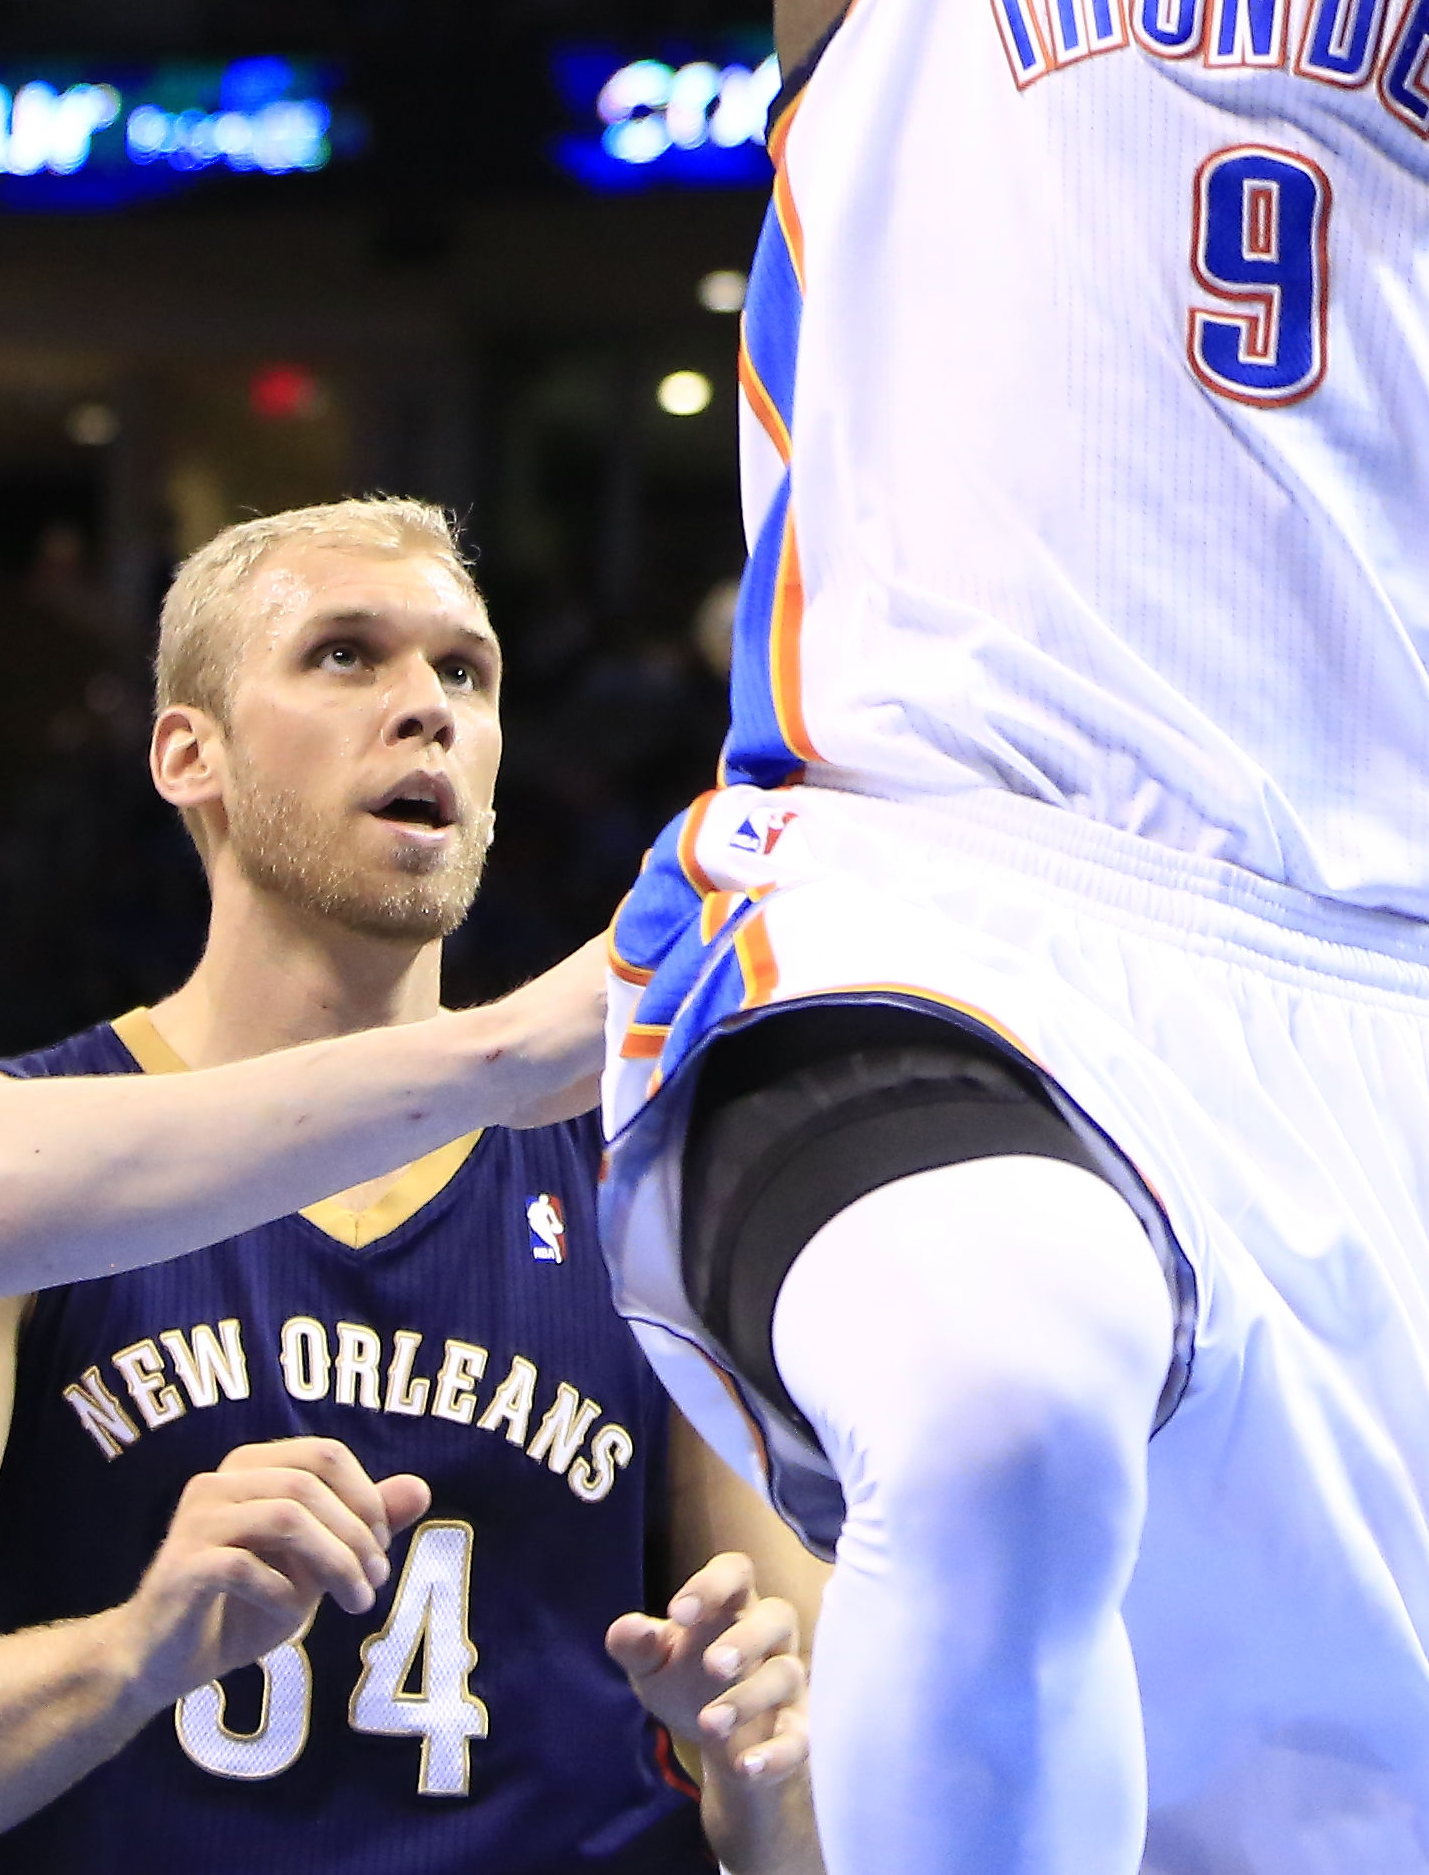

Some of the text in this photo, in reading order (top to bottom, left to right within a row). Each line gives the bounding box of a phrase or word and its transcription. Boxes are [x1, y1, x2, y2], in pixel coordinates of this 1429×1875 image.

[1187, 143, 1333, 409] 9
[62, 1313, 635, 1504] NEW ORLEANS
